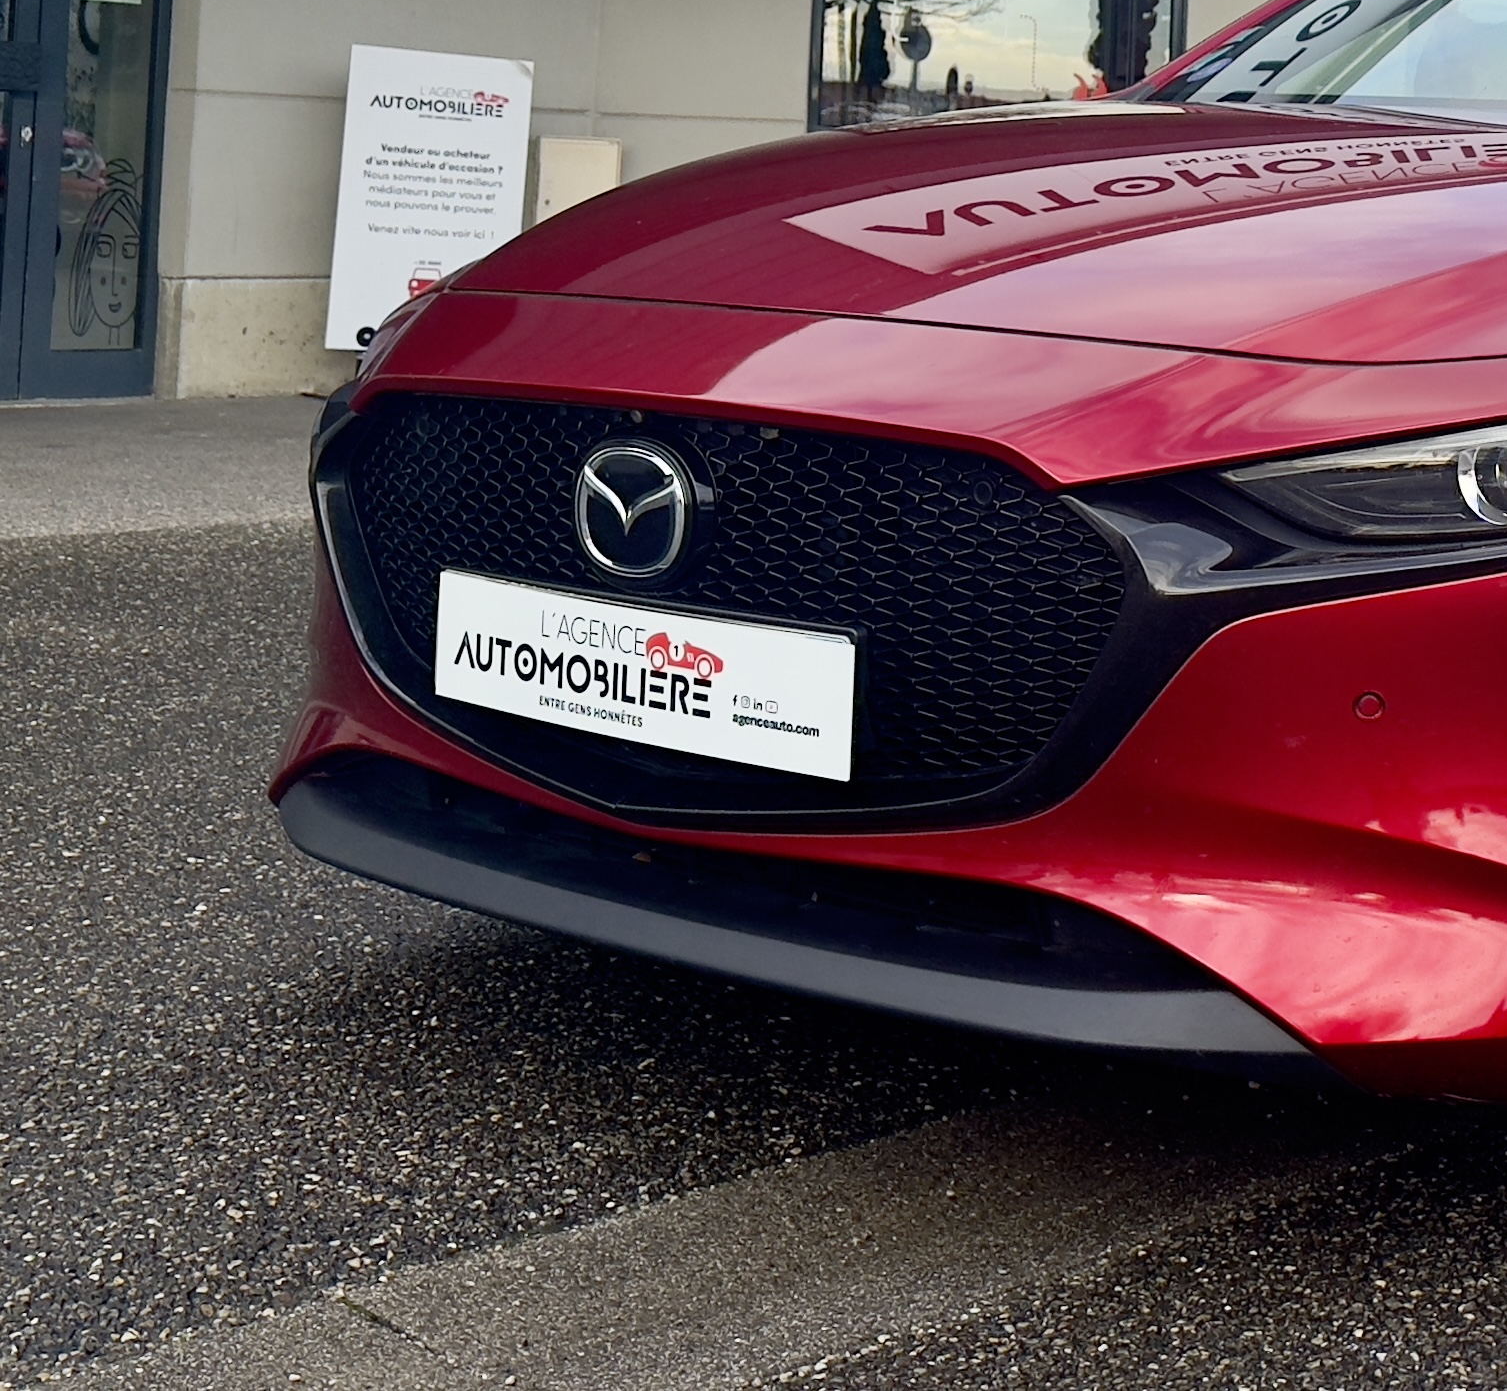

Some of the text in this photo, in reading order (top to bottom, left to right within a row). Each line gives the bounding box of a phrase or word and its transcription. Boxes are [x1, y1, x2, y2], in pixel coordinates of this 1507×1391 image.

[370, 94, 504, 118] AUTOMOBILIERE
[381, 143, 425, 156] Vendeur
[443, 148, 491, 160] acheteur
[365, 156, 389, 166] d'un
[392, 157, 436, 170] véhicule
[438, 161, 495, 174] d'occasion
[363, 169, 503, 189] Nous sommes les meilleurs
[368, 185, 496, 201] médiateurs pour vous et
[365, 199, 497, 216] nous pouvons le prouver.
[367, 223, 400, 235] Venez
[402, 226, 421, 235] vite
[423, 228, 449, 237] nous
[452, 228, 472, 239] voir
[474, 228, 486, 240] ici
[540, 609, 647, 658] L'AGENCE
[454, 630, 712, 719] AUTOMOBILIERE
[539, 695, 644, 729] ENTRE GENS HONNÊTES
[732, 713, 820, 738] agenceauto.com
